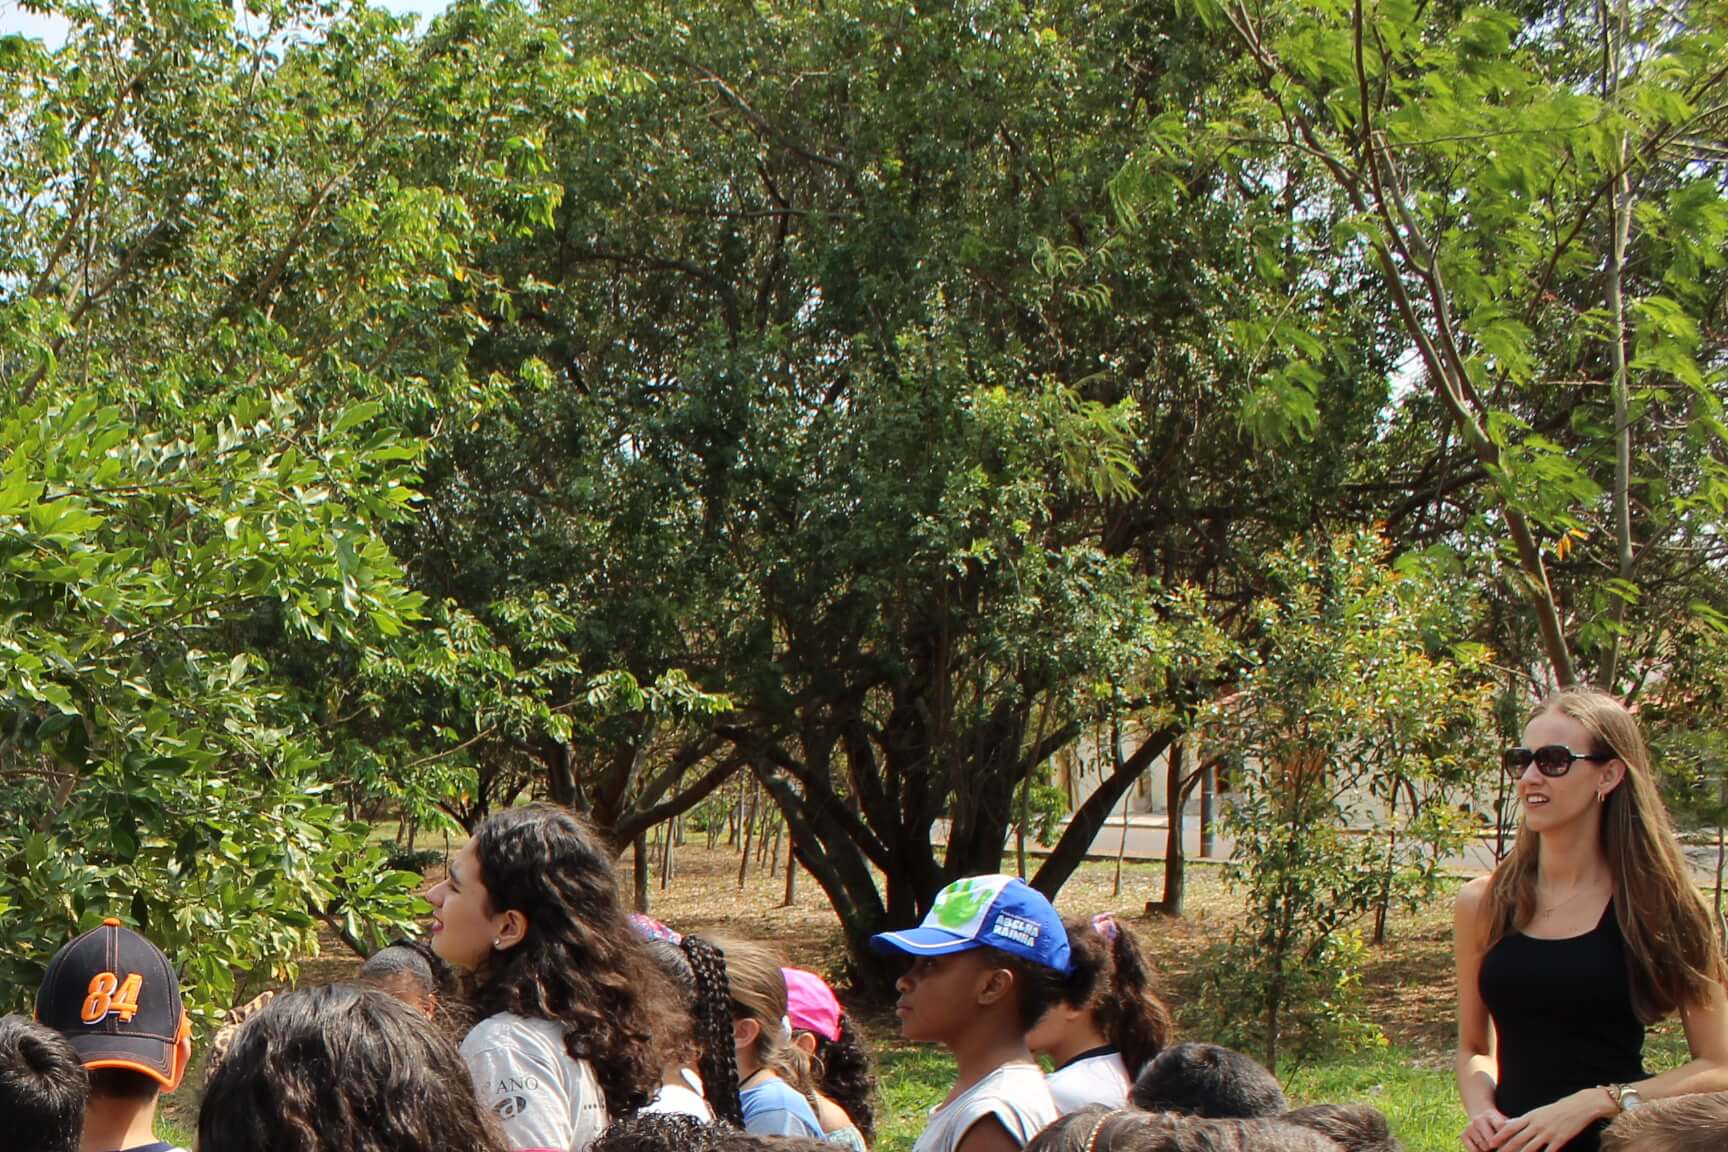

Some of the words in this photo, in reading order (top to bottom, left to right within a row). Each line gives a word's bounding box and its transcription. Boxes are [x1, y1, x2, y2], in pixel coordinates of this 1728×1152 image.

[992, 924, 1035, 947] RAINHA
[81, 972, 143, 1025] 84
[496, 1077, 538, 1095] ANO
